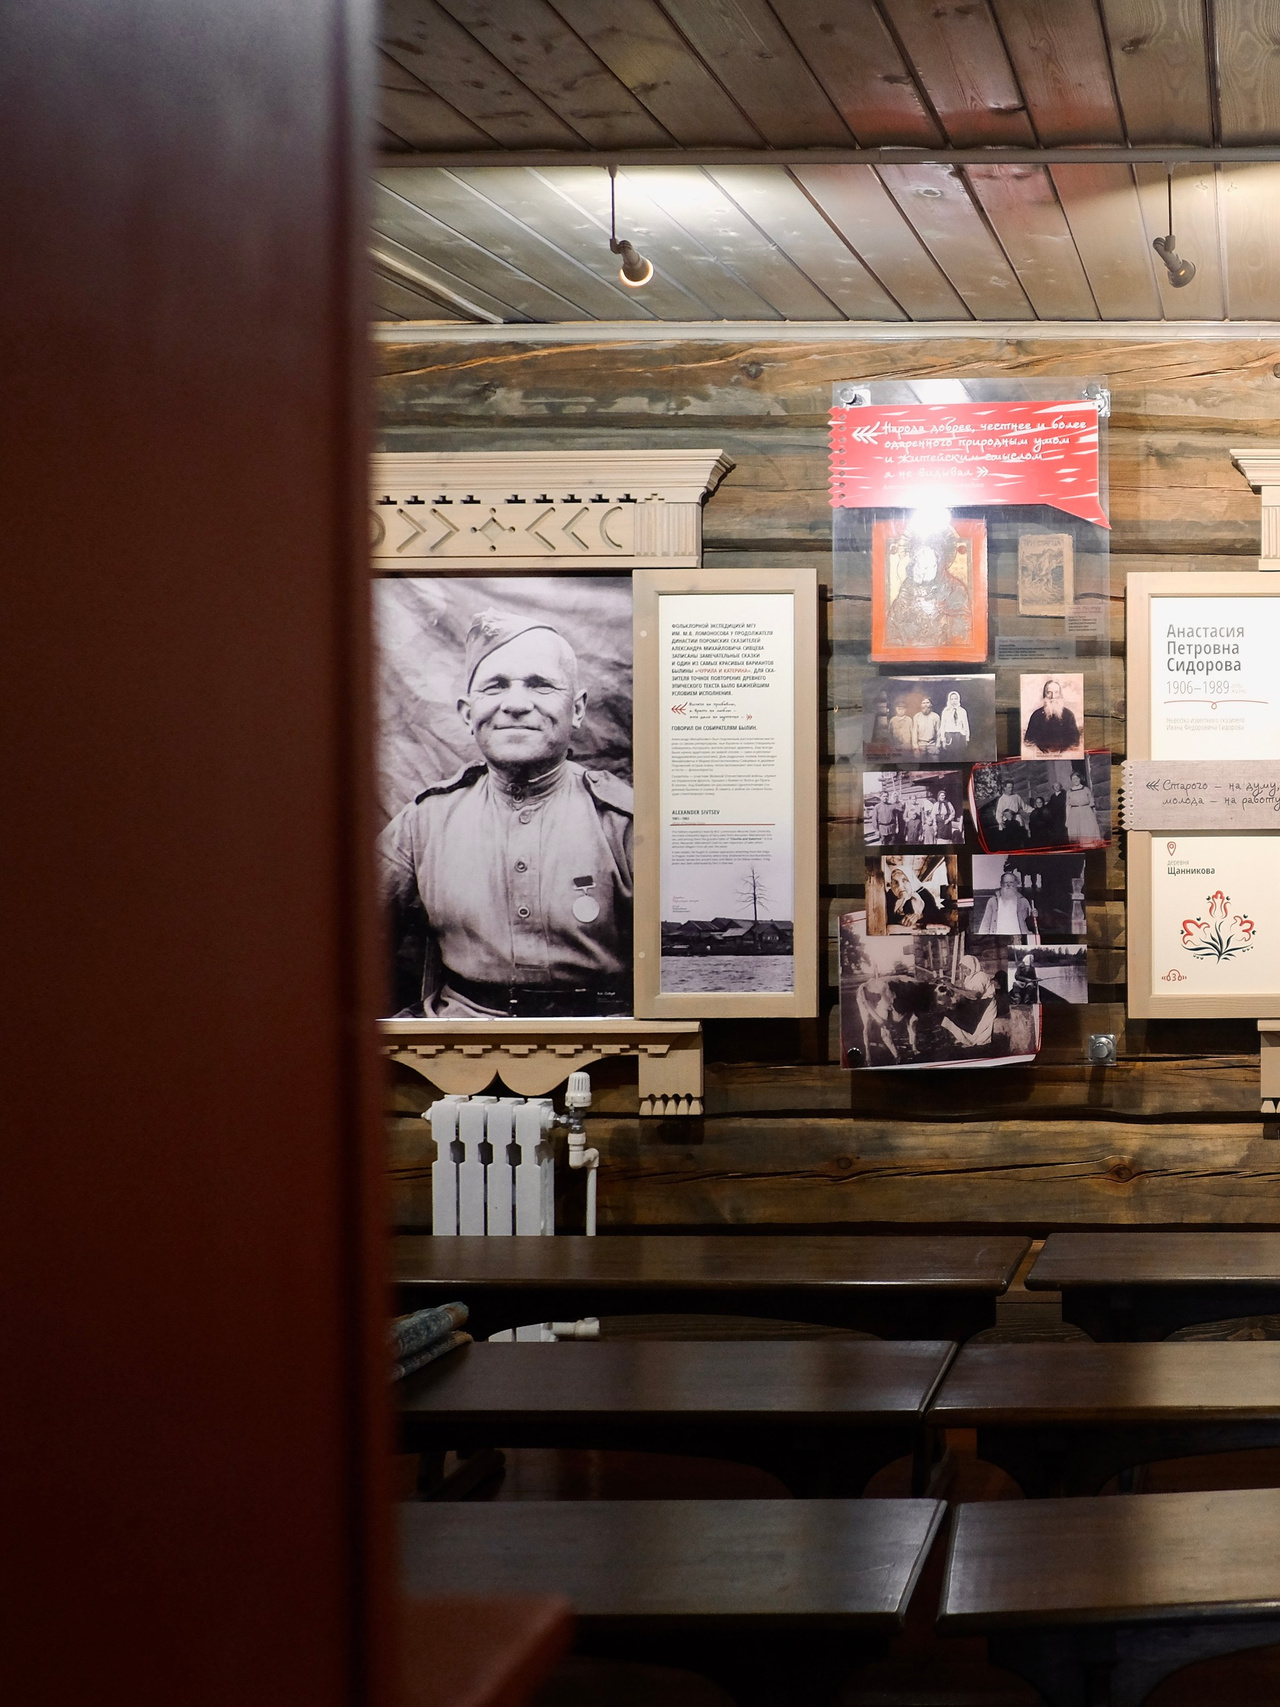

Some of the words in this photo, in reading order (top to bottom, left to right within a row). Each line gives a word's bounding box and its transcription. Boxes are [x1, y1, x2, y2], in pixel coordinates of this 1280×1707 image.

[883, 421, 925, 439] Народа
[931, 417, 975, 437] добрее,
[980, 422, 1031, 432] честнее
[1052, 416, 1086, 430] более
[959, 438, 1028, 454] природным
[1034, 438, 1070, 452] умом
[985, 452, 1042, 462] смыслом
[1167, 624, 1244, 638] Анастасия
[1168, 641, 1239, 659] Петровна
[1167, 658, 1241, 675] Сидорова
[1163, 780, 1208, 796] Старого
[1229, 782, 1241, 790] на
[1246, 782, 1280, 796] думу,
[1163, 798, 1204, 806] молода
[1225, 797, 1237, 805] на
[1167, 867, 1215, 876] Щанникова
